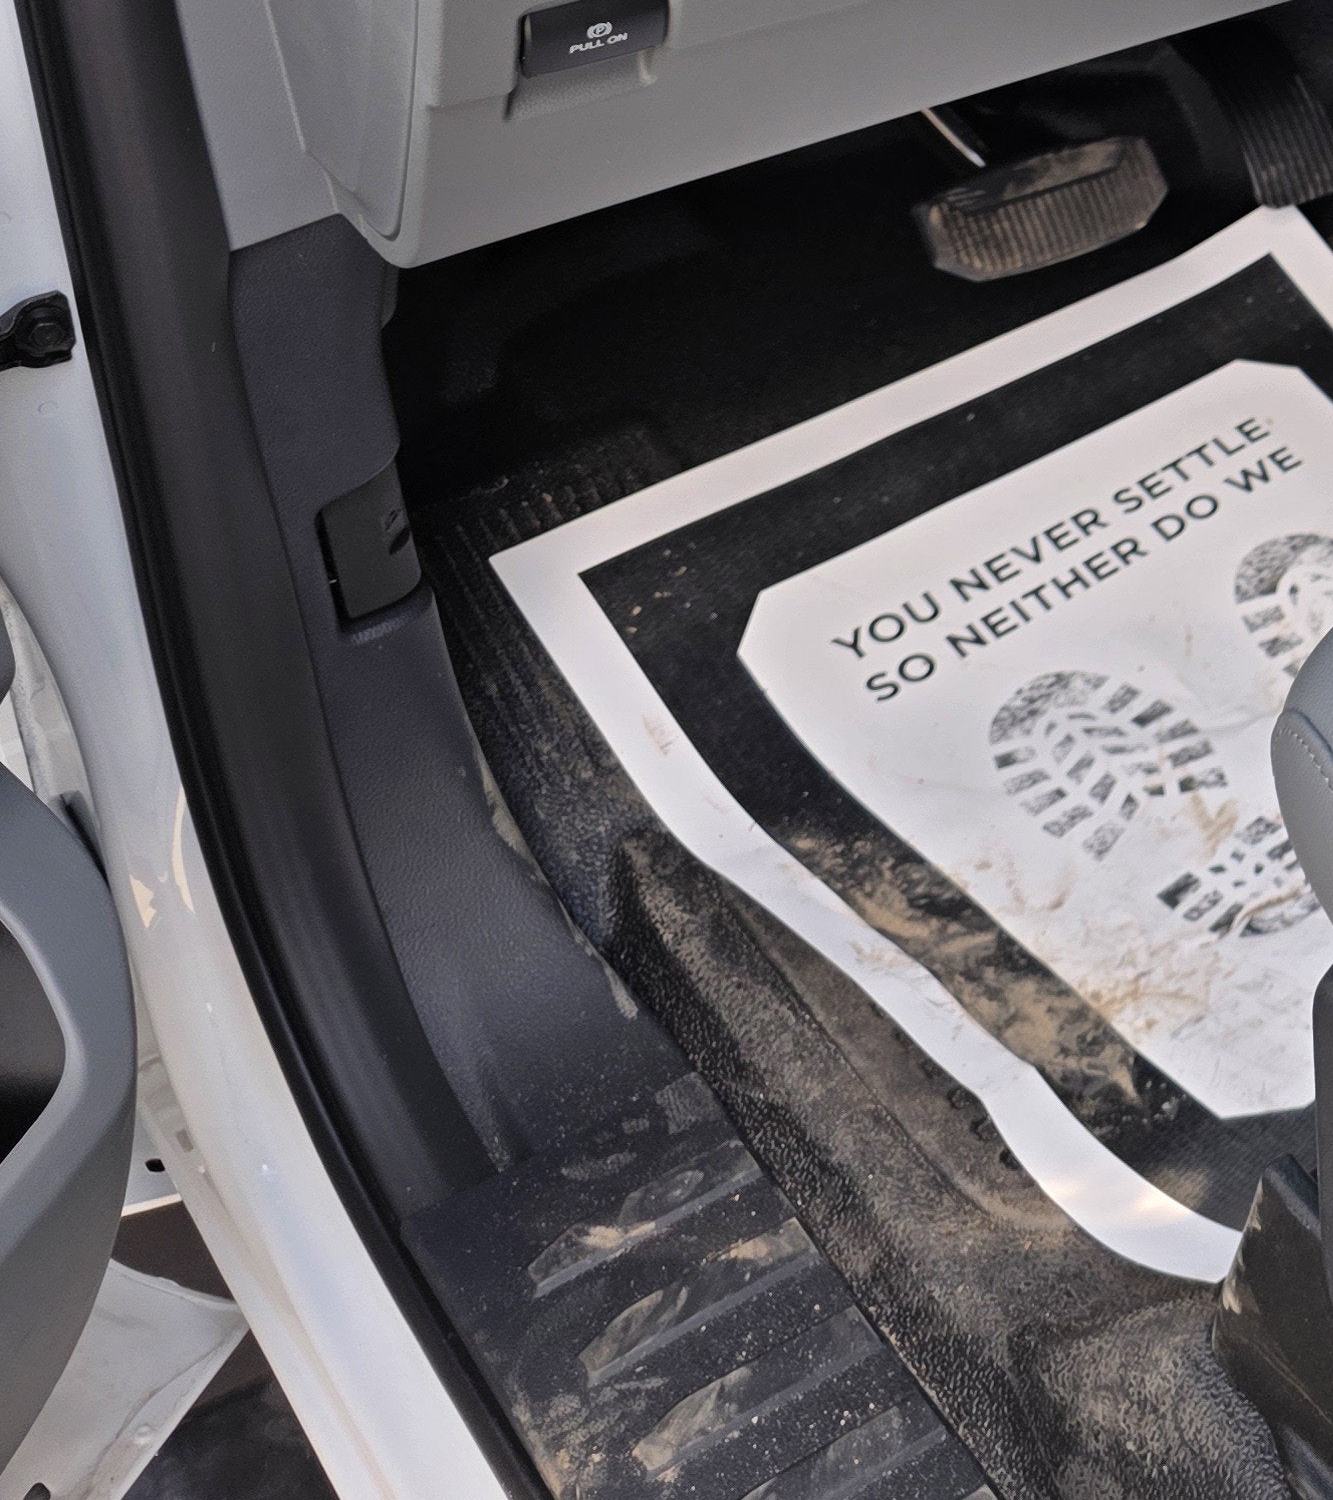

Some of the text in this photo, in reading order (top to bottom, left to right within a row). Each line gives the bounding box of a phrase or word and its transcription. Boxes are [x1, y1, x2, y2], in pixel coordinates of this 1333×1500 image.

[569, 32, 628, 54] PULL ON
[829, 417, 1270, 660] YOU NEVER SETTLE
[865, 446, 1303, 703] SO NEITHER DO WE
